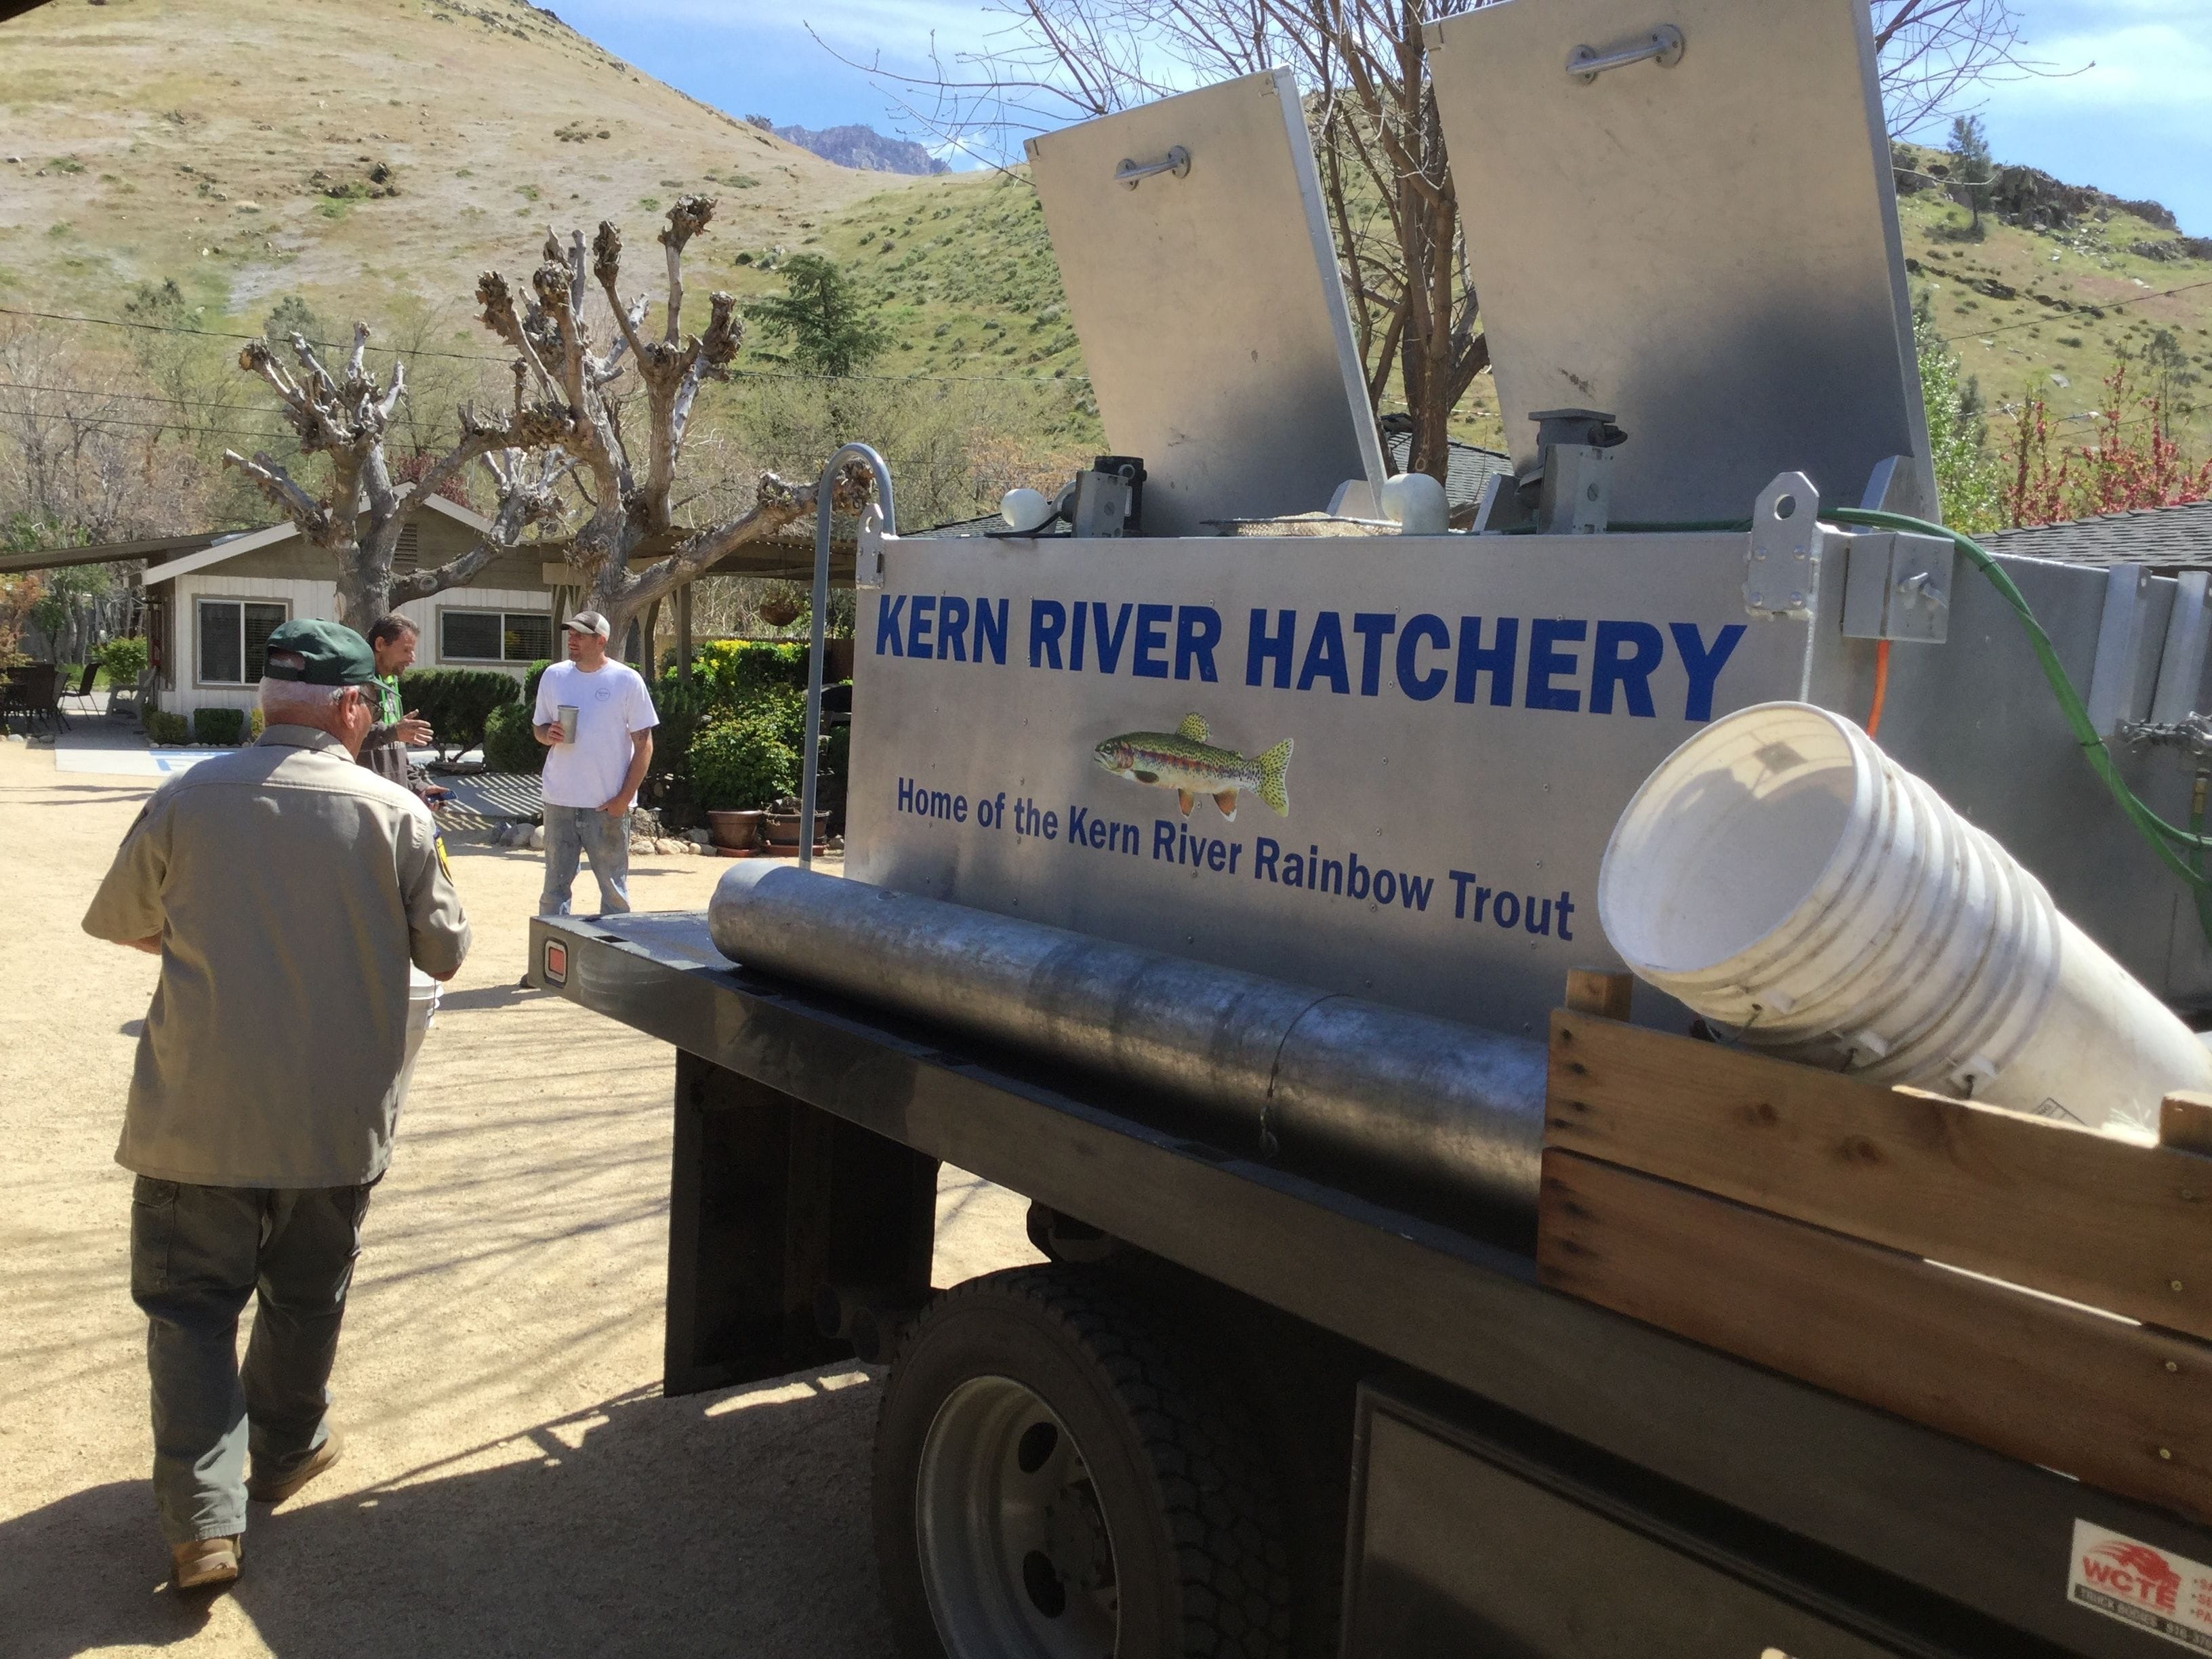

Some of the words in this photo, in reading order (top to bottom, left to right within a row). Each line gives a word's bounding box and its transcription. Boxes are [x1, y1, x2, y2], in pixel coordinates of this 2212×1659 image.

[876, 594, 1009, 665] KERN
[1029, 599, 1222, 683] RIVER
[1246, 608, 1747, 722] HATCHERY
[897, 777, 968, 823] Home
[977, 792, 1006, 830] of
[1014, 797, 1059, 840] the
[1068, 805, 1141, 855] Kern
[1152, 819, 1242, 875] River
[1254, 836, 1435, 912] Rainbow
[1448, 869, 1574, 941] Trout
[2083, 1555, 2177, 1610] WCTE
